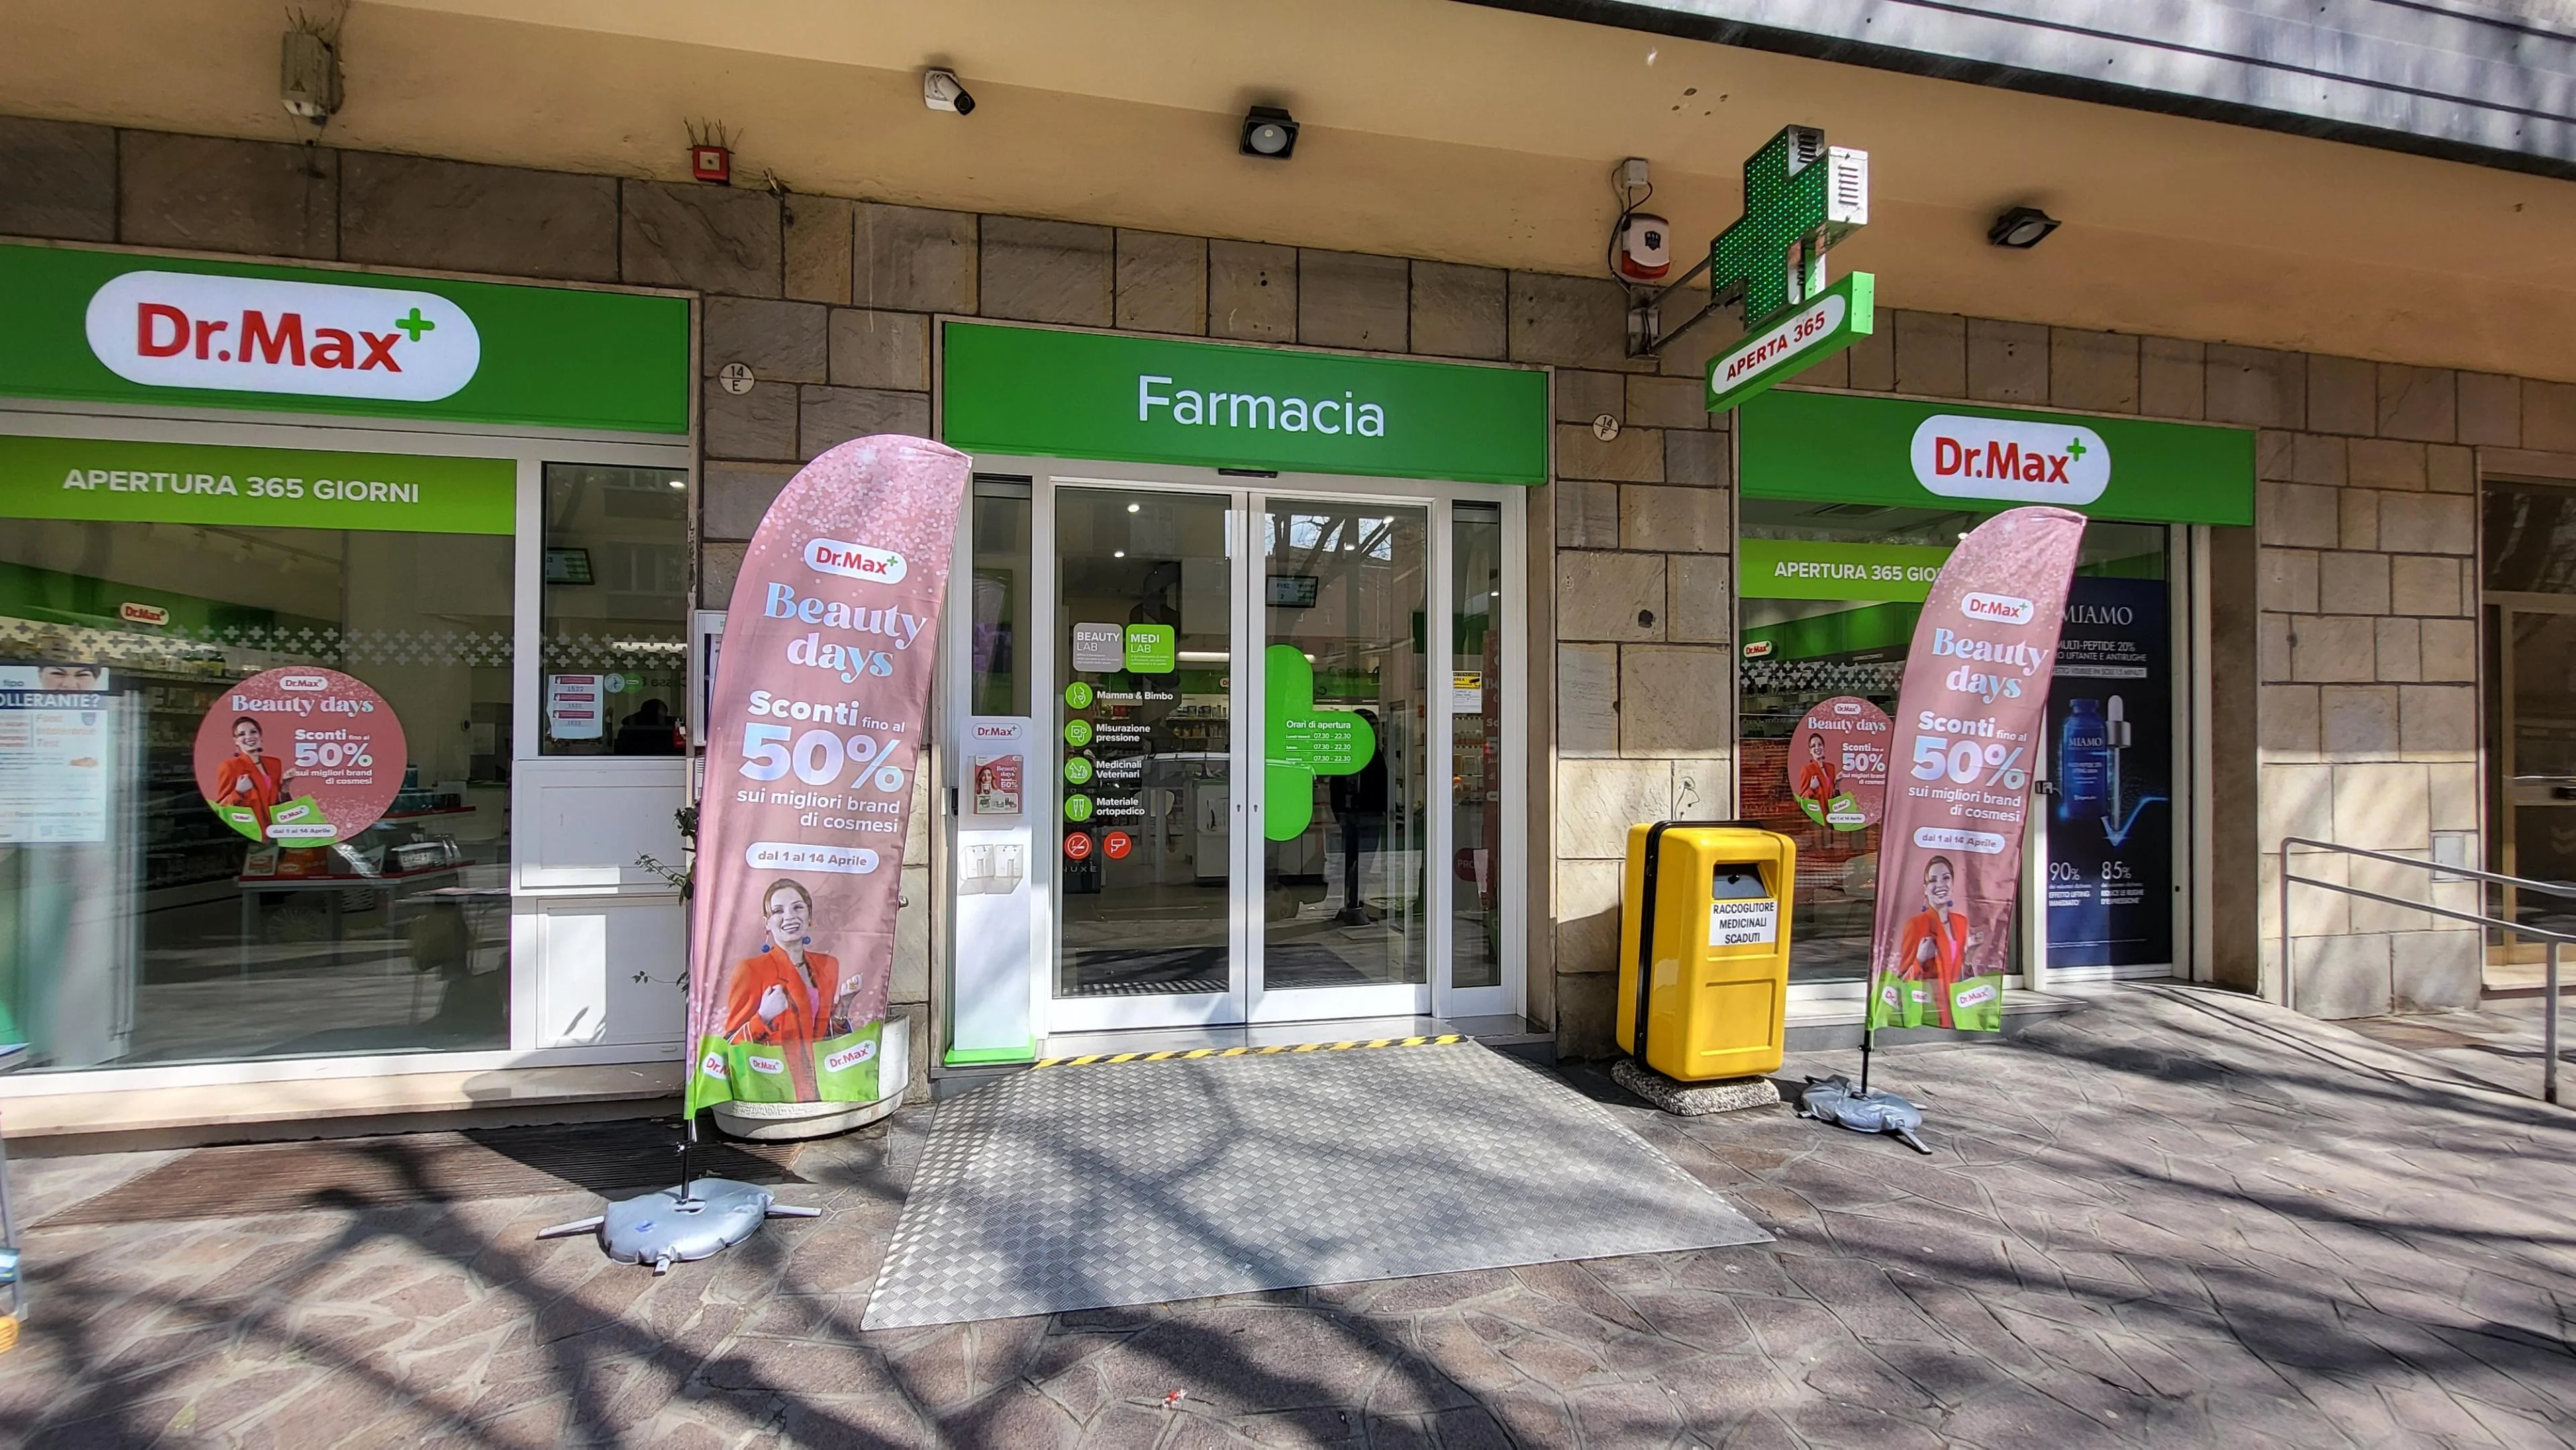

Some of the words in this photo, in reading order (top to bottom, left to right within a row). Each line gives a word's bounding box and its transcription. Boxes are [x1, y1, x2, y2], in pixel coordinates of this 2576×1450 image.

[1726, 334, 1787, 382] APERTA
[1793, 311, 1825, 344] 365
[731, 365, 744, 378] 14
[732, 380, 741, 392] E
[1138, 374, 1385, 437] Farmacia
[1603, 416, 1614, 428] 14
[63, 468, 238, 497] APERTURA
[246, 477, 304, 499] 365
[313, 479, 419, 503] GIORNI
[1774, 562, 1868, 580] APERTURA
[1871, 565, 1903, 581] 365
[1907, 566, 1942, 582] GIO
[763, 581, 928, 650] Beauty
[2063, 605, 2133, 625] MIAMO
[1077, 631, 1120, 642] BEAUTY
[1130, 633, 1160, 643] MEDI
[1077, 642, 1098, 651] LAB
[1130, 644, 1151, 653] LAB
[1931, 627, 2050, 676] Beauty
[2117, 641, 2136, 652] 20%
[787, 632, 895, 684] days
[2067, 652, 2098, 660] LIFTANTE
[3, 679, 25, 688] tipo
[1946, 665, 2022, 704] days
[1097, 690, 1134, 701] Mamma
[1136, 691, 1142, 701] &
[1144, 691, 1174, 701] Bimbo
[232, 694, 314, 717] Beauty
[319, 696, 375, 717] days
[747, 690, 860, 727] Sconti
[862, 717, 889, 731] fino
[892, 721, 905, 733] al
[1096, 724, 1151, 733] Misurazione
[1286, 720, 1307, 729] Orari
[1308, 720, 1316, 729] di
[1318, 721, 1351, 730] apertura
[1807, 717, 1853, 734] Beauty
[1856, 719, 1887, 734] days
[1918, 710, 1996, 737] Sconti
[1996, 729, 2016, 741] fino
[2018, 733, 2028, 741] al
[295, 728, 347, 740] Sconti
[1096, 733, 1140, 743] pressione
[1842, 743, 1871, 752] Sconti
[2068, 737, 2102, 747] MIAMO
[294, 742, 373, 767] 50%
[738, 721, 905, 792] 50%
[1096, 760, 1142, 769] Medicinali
[1842, 753, 1885, 772] 50%
[1910, 735, 2026, 790] 50%
[311, 769, 344, 778] migliori
[1096, 770, 1140, 778] Veterinari
[736, 787, 766, 804] sui
[771, 789, 842, 810] migliori
[847, 796, 901, 814] brand
[1096, 797, 1139, 807] Materiale
[1908, 785, 1928, 797] sui
[1932, 786, 1980, 802] migliori
[1983, 792, 2021, 807] brand
[1096, 807, 1146, 817] ortopedico
[1950, 805, 1962, 816] di
[1965, 807, 2020, 822] cosmesi
[800, 811, 818, 827] di
[824, 815, 899, 833] cosmesi
[1922, 834, 1936, 842] dal
[1944, 835, 1952, 843] al
[1954, 835, 1964, 844] 14
[1966, 837, 1996, 848] Aprile
[758, 850, 779, 861] dal
[783, 851, 789, 862] 1
[792, 852, 805, 863] al
[809, 853, 824, 864] 14
[828, 854, 867, 868] Aprile
[2050, 862, 2081, 881] 90%
[2101, 861, 2132, 880] 85%
[1713, 901, 1775, 915] RACCOGLITORE
[1719, 917, 1767, 929] MEDICINALI
[1724, 933, 1761, 944] SCADUTI
